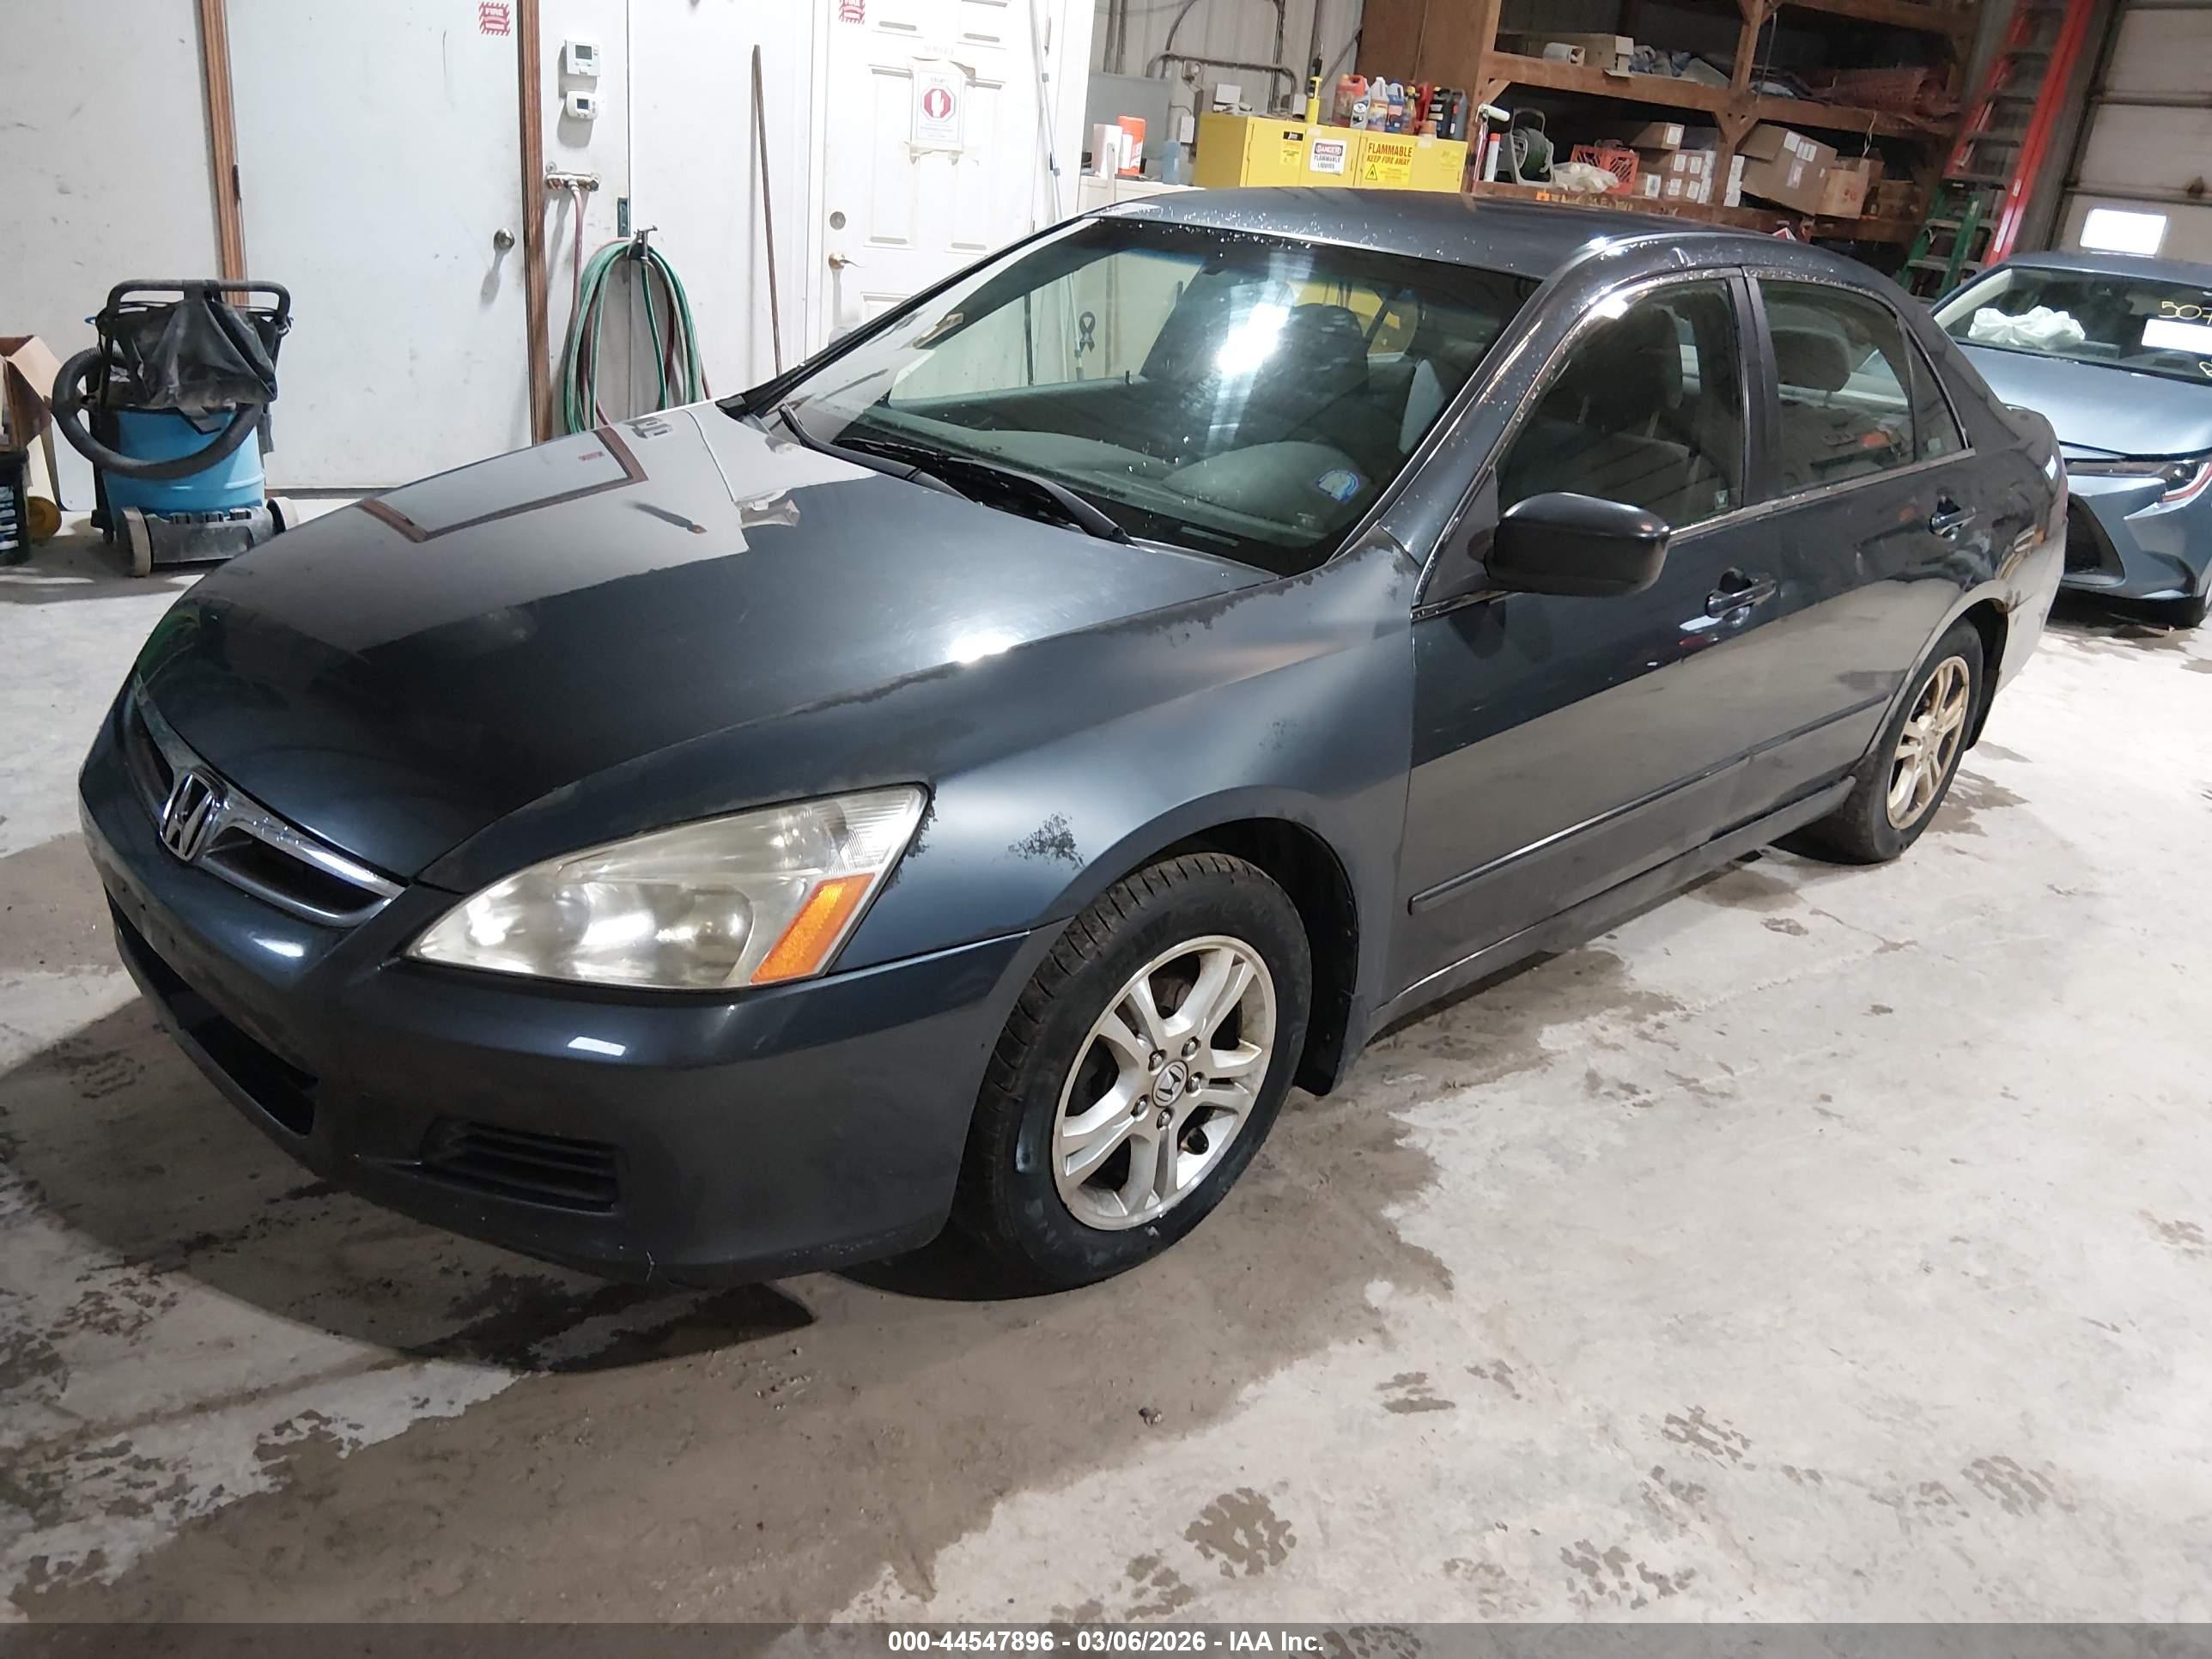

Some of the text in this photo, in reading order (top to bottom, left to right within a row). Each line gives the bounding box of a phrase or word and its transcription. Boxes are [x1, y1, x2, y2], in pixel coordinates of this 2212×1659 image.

[485, 8, 504, 16] FIRE
[1368, 143, 1413, 157] FLAMMABLE
[1314, 155, 1341, 163] FLAMMABLE
[1366, 155, 1382, 163] KEEP
